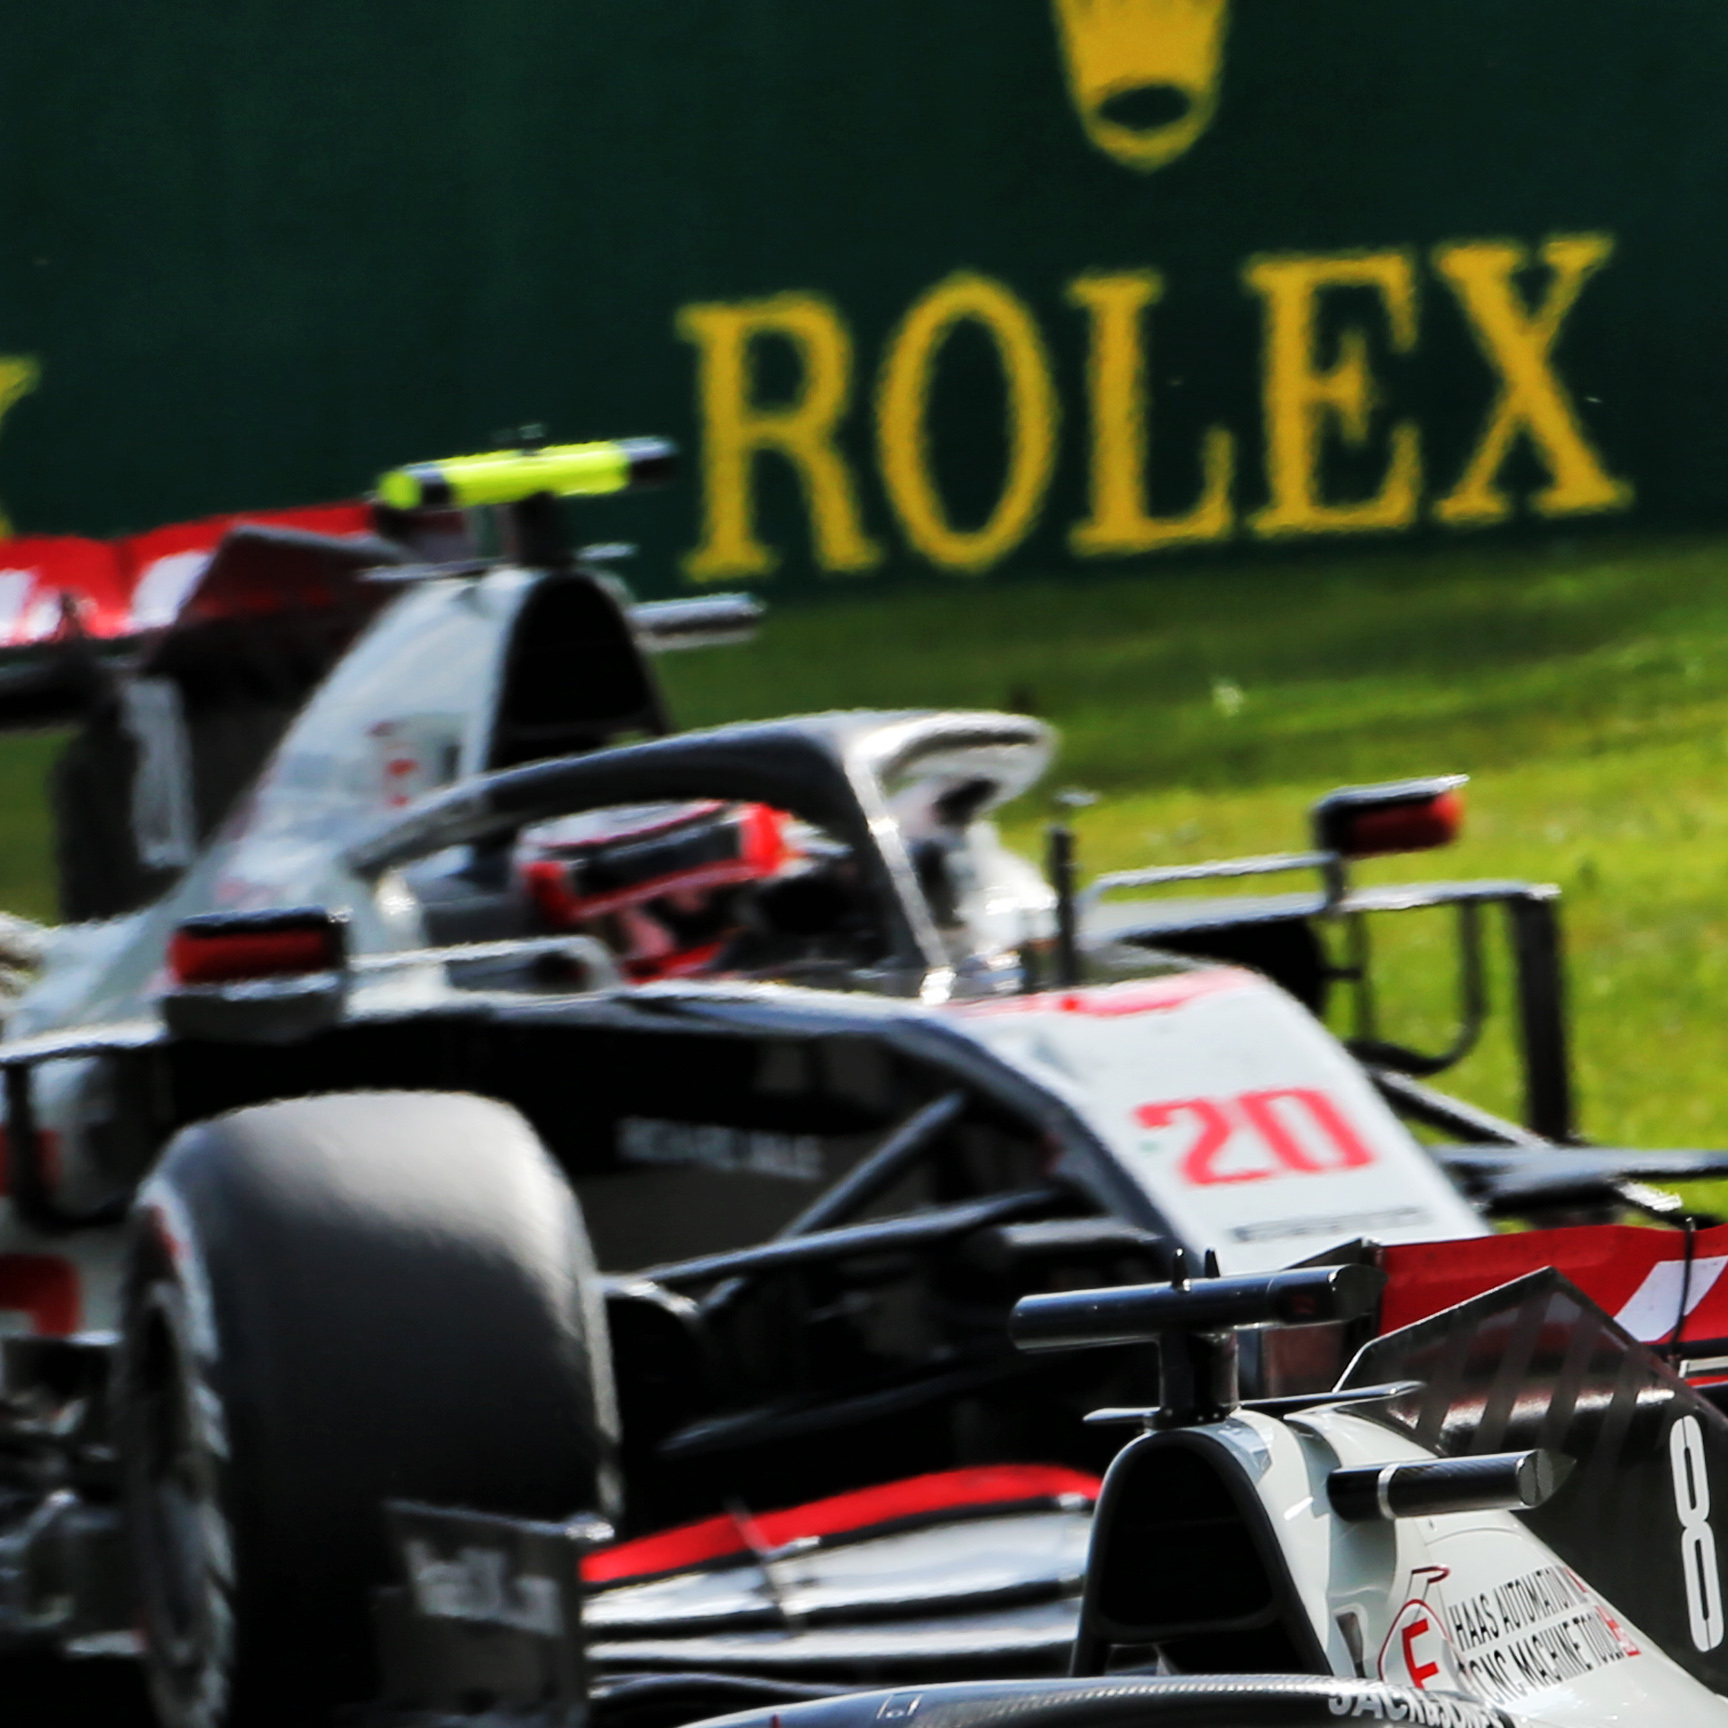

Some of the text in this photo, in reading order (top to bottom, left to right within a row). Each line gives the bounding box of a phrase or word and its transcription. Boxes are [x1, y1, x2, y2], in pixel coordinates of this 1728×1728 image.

[677, 232, 1630, 582] ROLEX
[1134, 1087, 1374, 1186] 20
[1670, 1413, 1724, 1653] 8
[1448, 1593, 1500, 1652] HAAS
